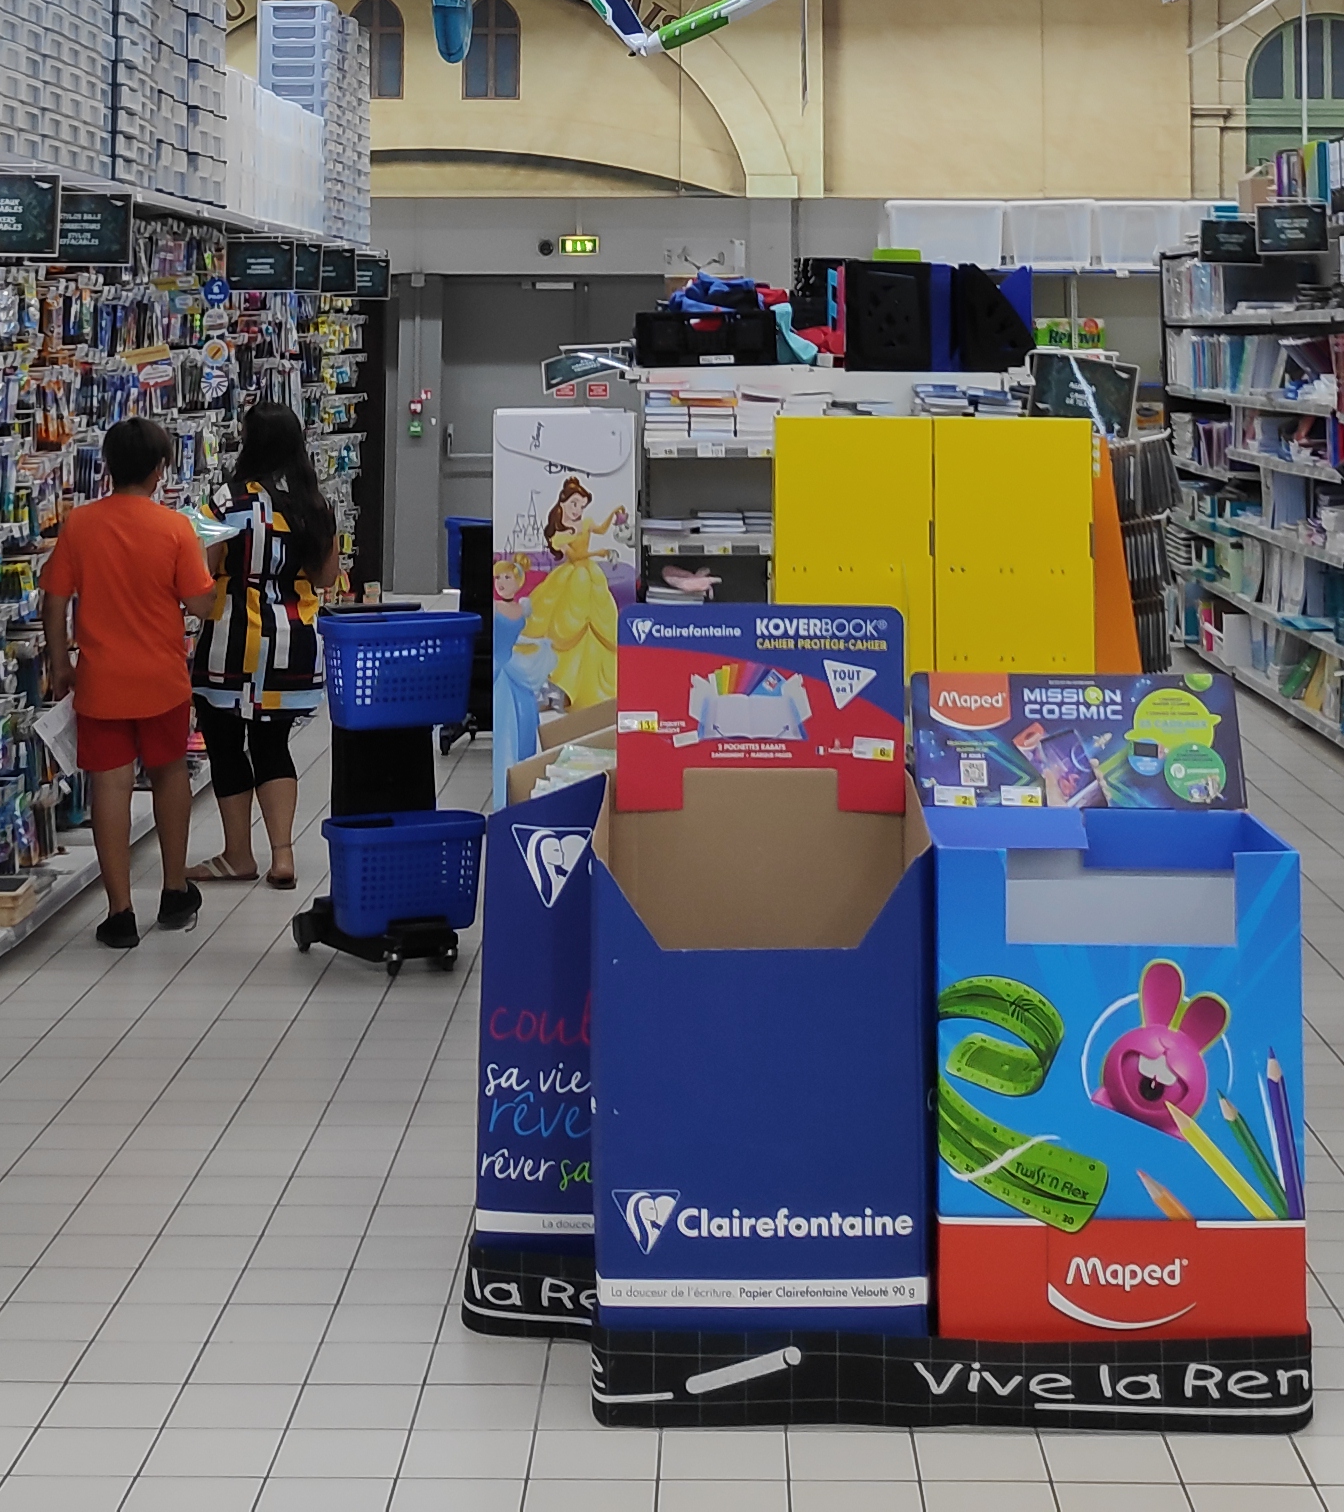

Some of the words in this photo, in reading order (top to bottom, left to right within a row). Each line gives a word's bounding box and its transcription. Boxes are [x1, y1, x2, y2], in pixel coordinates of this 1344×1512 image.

[651, 623, 742, 638] Clairefontaine
[756, 638, 795, 650] CAHIER
[832, 668, 861, 681] TOUT
[938, 691, 1003, 711] Maped
[1023, 686, 1123, 706] MISSION
[1024, 704, 1124, 720] COSMIC
[484, 1062, 529, 1097] sa
[539, 1063, 591, 1093] vie
[480, 1148, 555, 1183] rêver
[1060, 1181, 1090, 1201] Flex
[541, 1217, 553, 1229] La
[677, 1207, 913, 1238] Clairefontaine
[1066, 1257, 1184, 1292] Maped
[472, 1267, 524, 1307] la
[611, 1287, 623, 1298] La
[625, 1287, 667, 1299] douceur
[671, 1287, 684, 1298] de
[739, 1287, 773, 1300] Papier
[775, 1286, 848, 1299] Clairefontaine
[851, 1285, 889, 1298] Velouté
[892, 1285, 906, 1297] 90
[913, 1362, 1076, 1400] Vive
[1098, 1364, 1163, 1400] la
[1183, 1363, 1310, 1400] Ren
